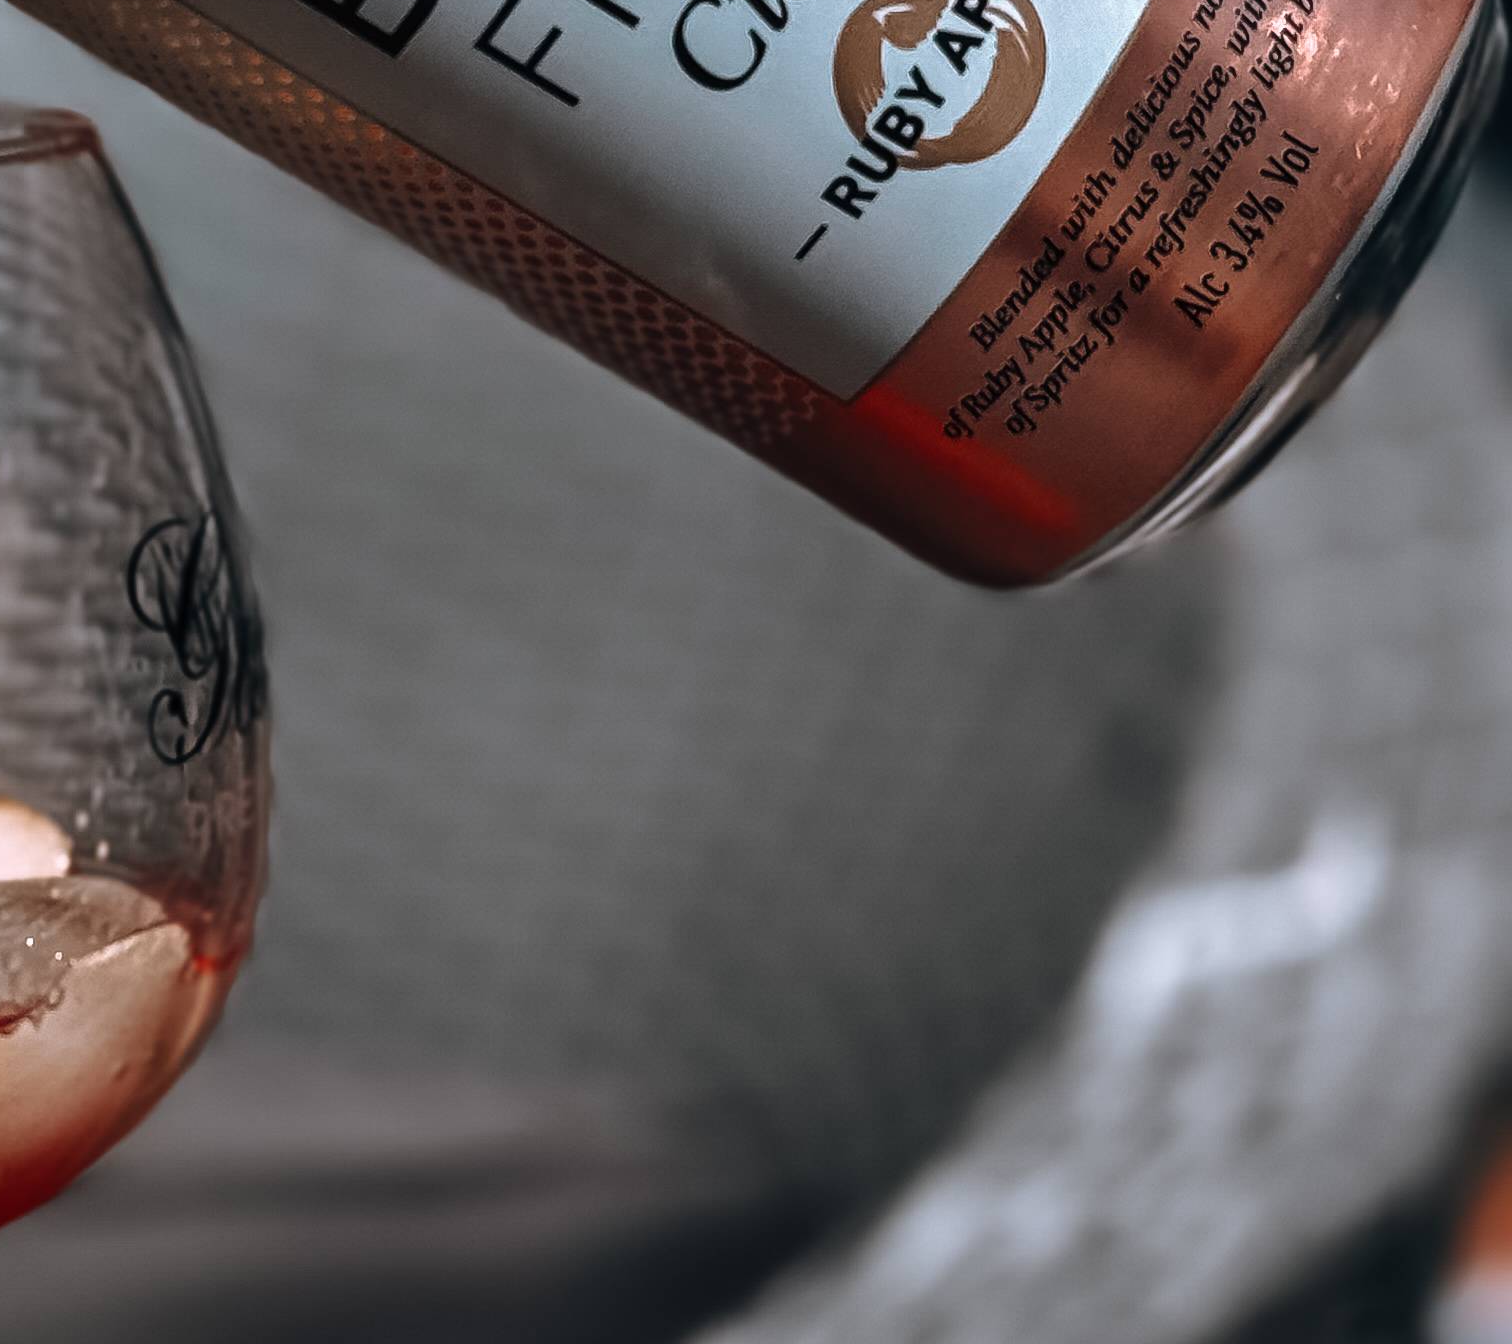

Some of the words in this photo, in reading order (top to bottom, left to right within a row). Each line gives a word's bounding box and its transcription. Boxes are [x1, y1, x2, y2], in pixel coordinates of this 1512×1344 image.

[821, 66, 945, 219] RUBY
[943, 407, 974, 439] of
[961, 356, 1025, 419] Ruby
[1019, 280, 1096, 363] Apple,
[1085, 181, 1159, 272] Citrus
[1150, 150, 1180, 180] &
[1169, 65, 1237, 149] Spice,
[969, 236, 1065, 352] Blended
[1061, 170, 1116, 241] with
[1109, 31, 1200, 170] delicious
[1005, 399, 1037, 435] of
[1023, 335, 1098, 411] Spritz
[1088, 290, 1128, 346] for
[1129, 267, 1150, 293] a
[1145, 89, 1266, 269] refreshingly
[1250, 13, 1303, 90] light
[1173, 272, 1230, 328] Alc
[1209, 190, 1285, 271] 3.4%
[1260, 130, 1319, 187] Vol
